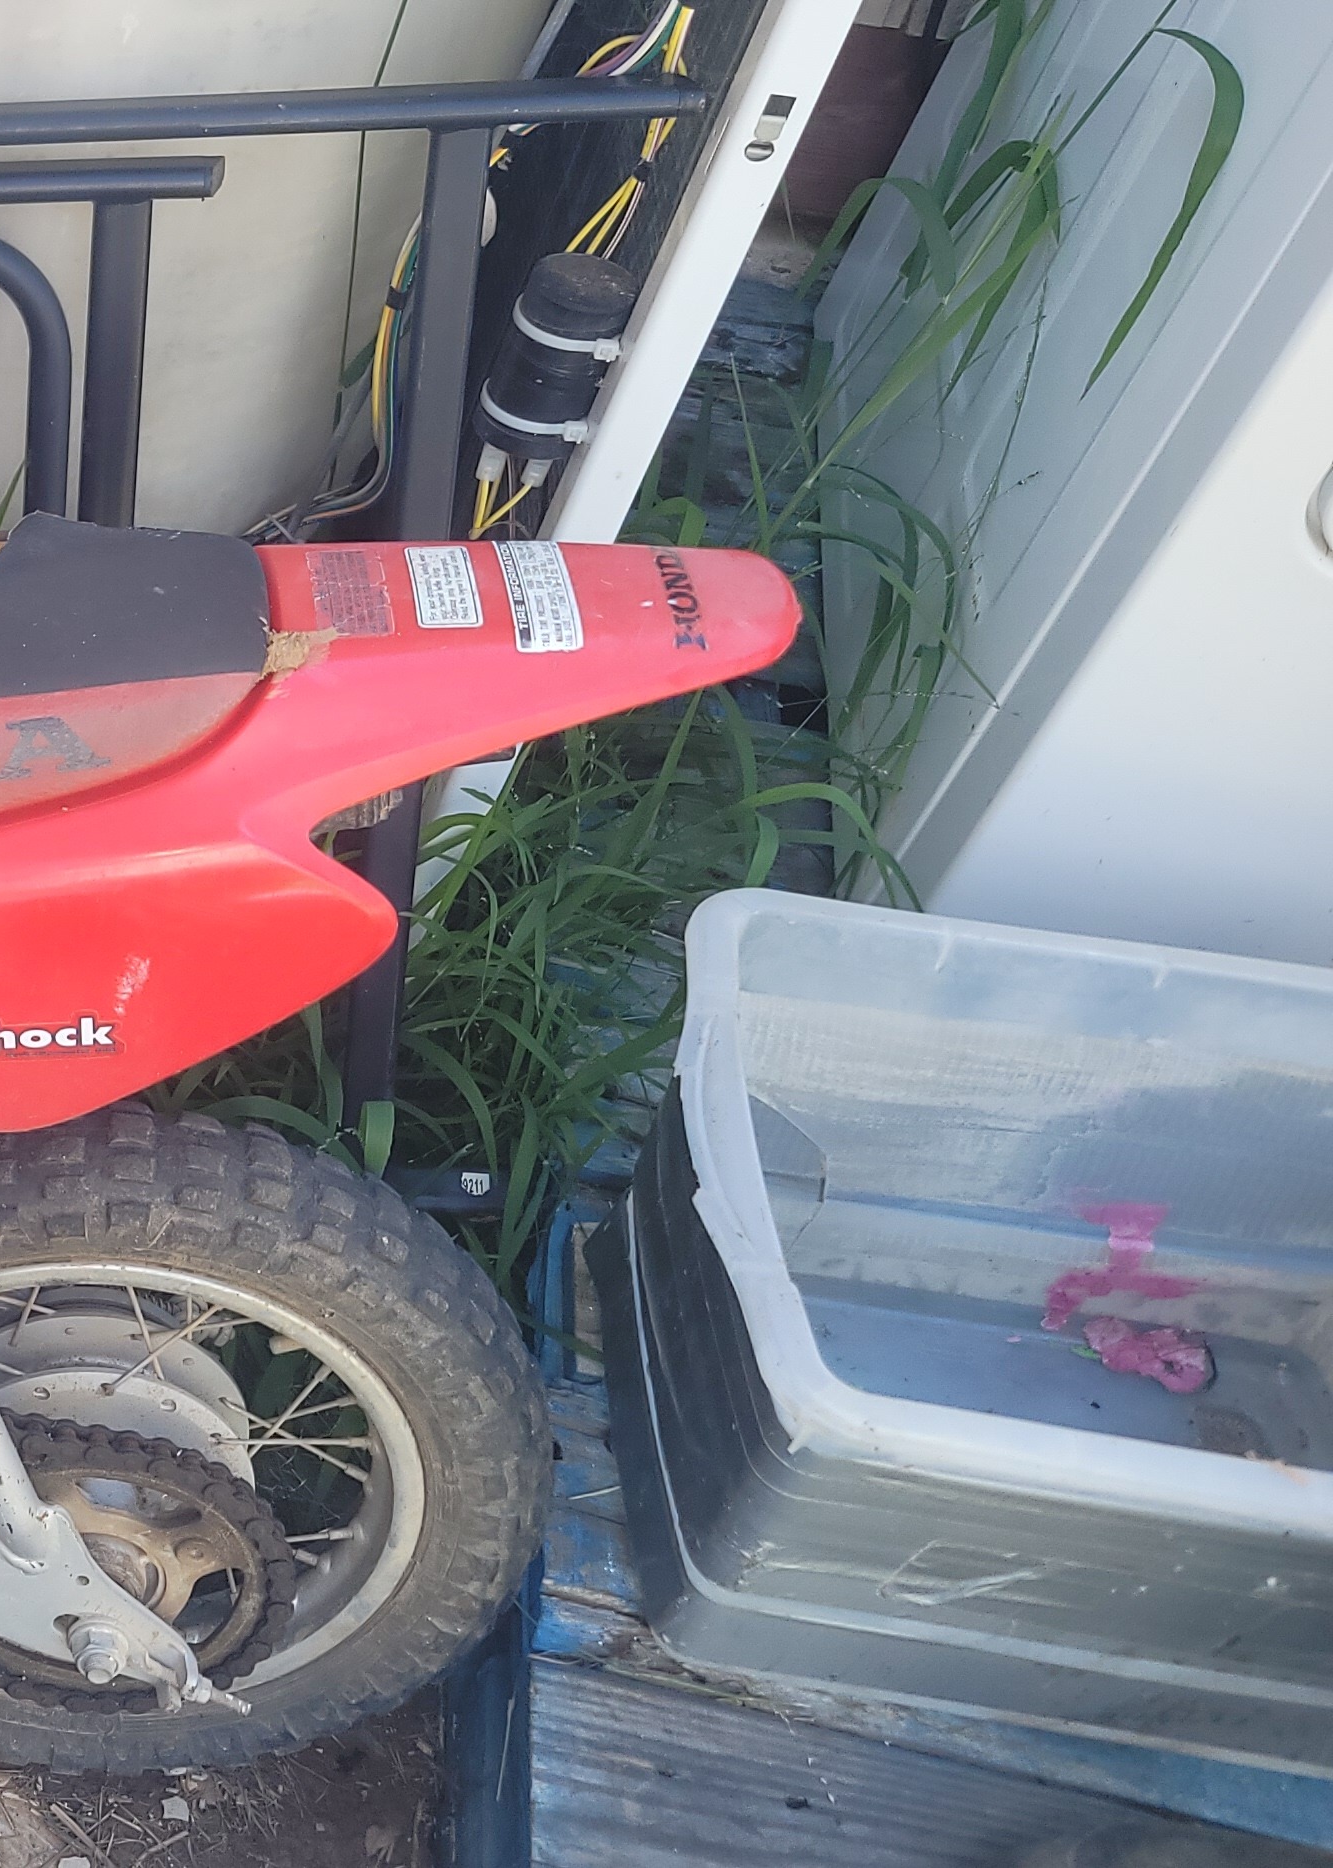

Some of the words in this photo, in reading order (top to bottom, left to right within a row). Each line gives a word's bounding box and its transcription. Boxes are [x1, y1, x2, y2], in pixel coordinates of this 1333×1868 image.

[498, 543, 524, 602] INFORMATION
[654, 548, 708, 651] HOND
[515, 603, 529, 631] TIRE
